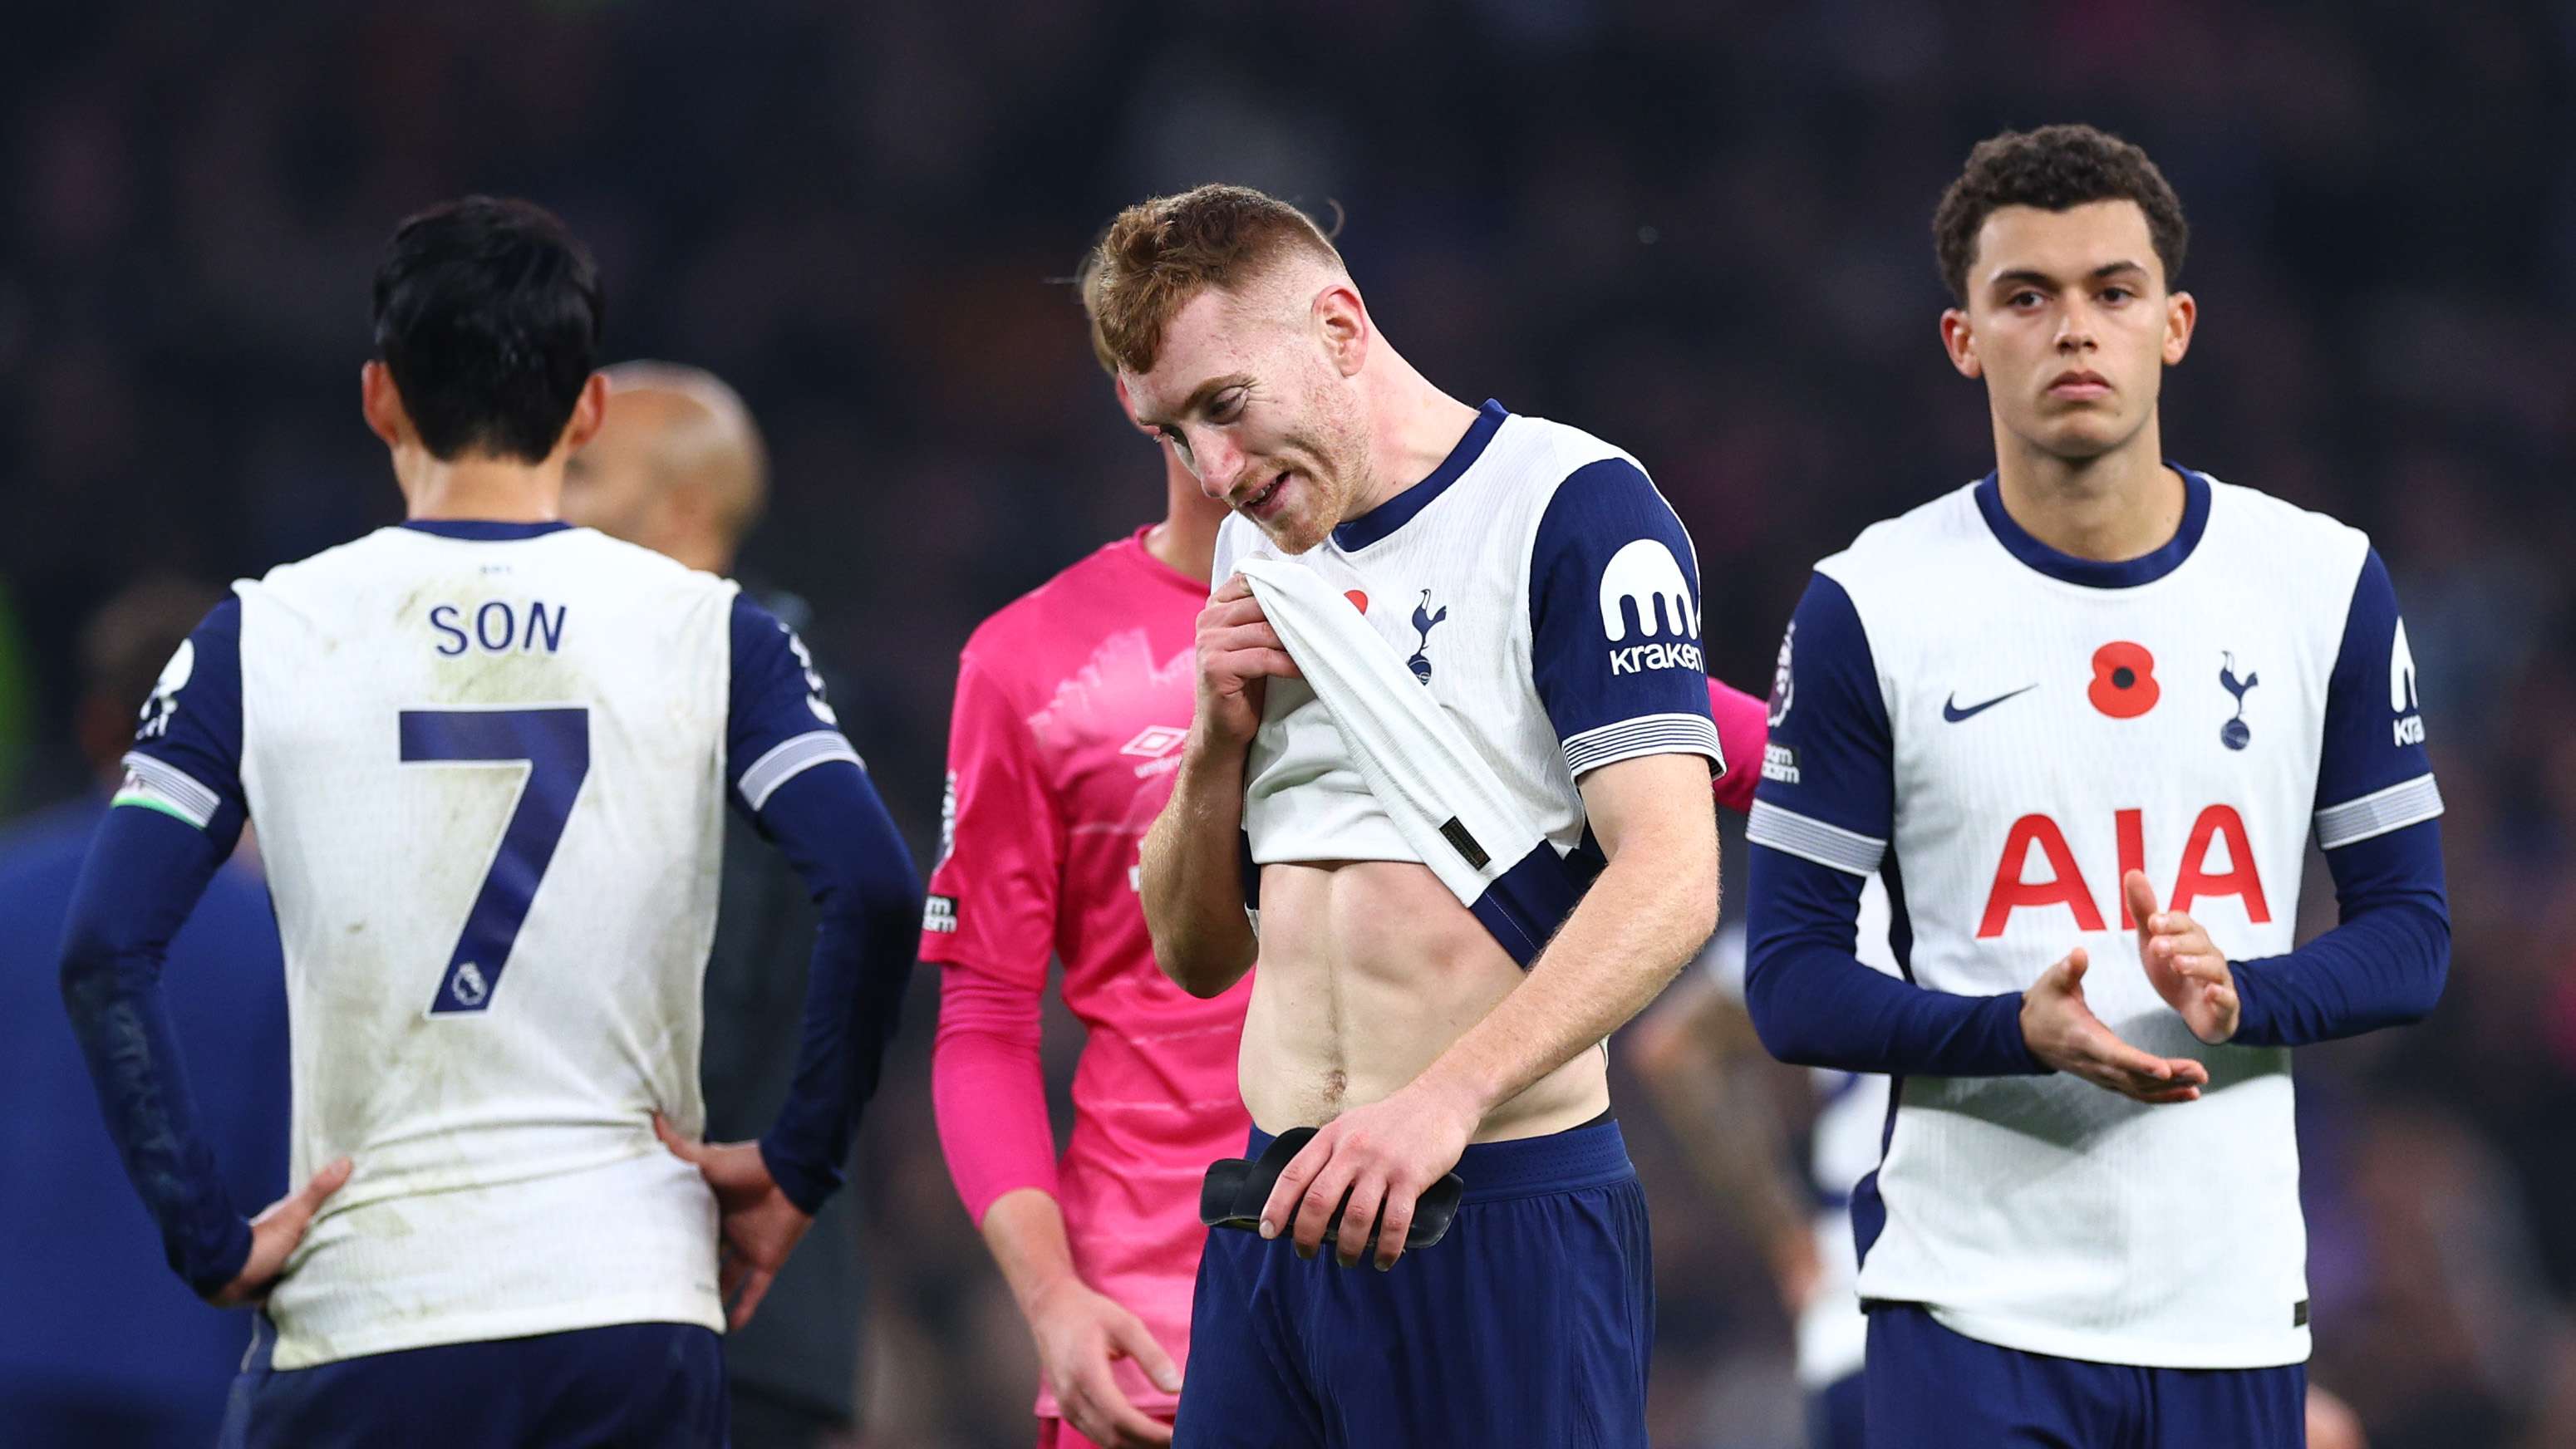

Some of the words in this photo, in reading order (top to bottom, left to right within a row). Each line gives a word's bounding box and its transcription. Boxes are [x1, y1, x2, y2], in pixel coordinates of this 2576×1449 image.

[430, 601, 567, 655] SON
[1609, 642, 1703, 675] kraken
[399, 708, 590, 1014] 7
[1975, 803, 2272, 939] AIA
